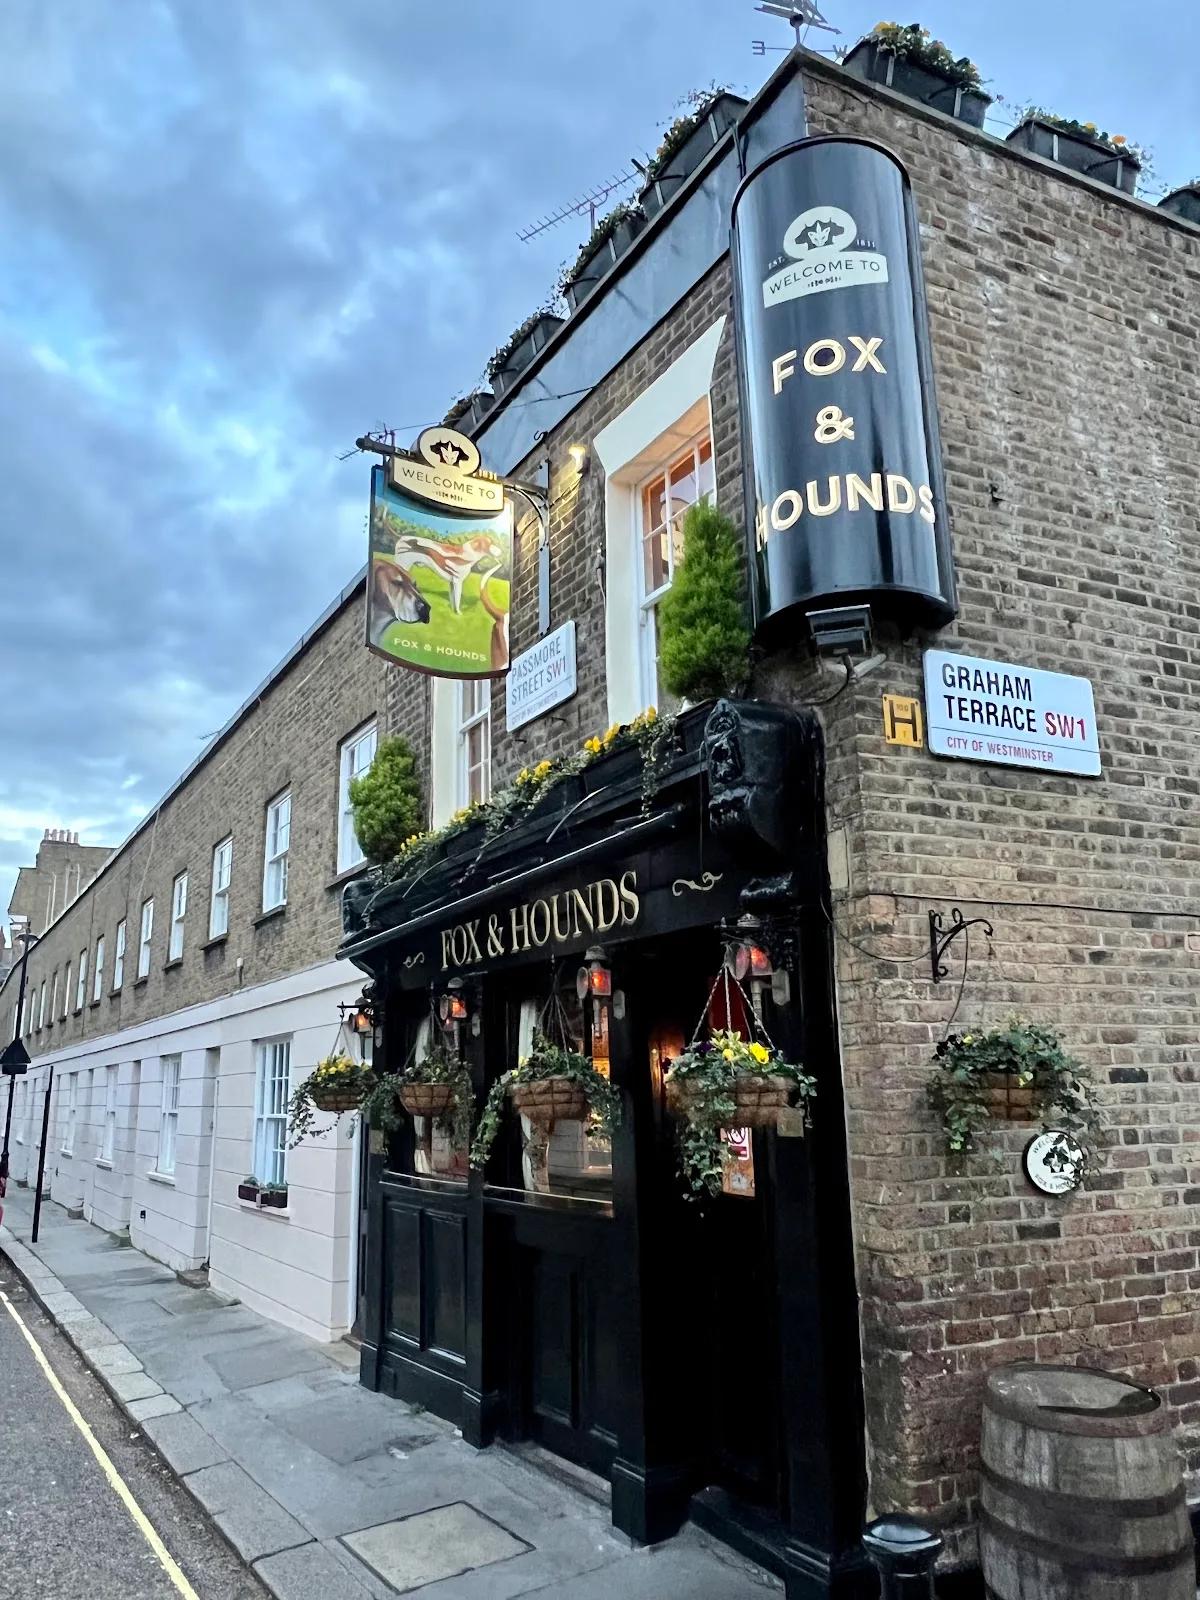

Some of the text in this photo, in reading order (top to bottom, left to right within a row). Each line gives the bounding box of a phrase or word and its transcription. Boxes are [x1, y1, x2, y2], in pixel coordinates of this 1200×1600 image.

[769, 259, 854, 294] WELCOME
[860, 259, 880, 272] TO
[772, 336, 887, 395] FOX
[814, 405, 855, 444] &
[402, 467, 474, 494] WELCOME
[479, 487, 496, 499] TO
[755, 472, 936, 552] HOUNDS
[394, 637, 487, 662] FOX & HOUNDS
[511, 635, 562, 685] PASSMORE
[511, 655, 566, 706] STREET SW1
[942, 663, 1032, 701] GRAHAM
[889, 700, 918, 741] H
[943, 695, 1086, 741] TERRACE SW1
[947, 736, 1054, 762] CITY OF WESTMINSTER
[440, 870, 640, 971] FOX & HOUNDS
[1033, 1136, 1055, 1153] WELCO
